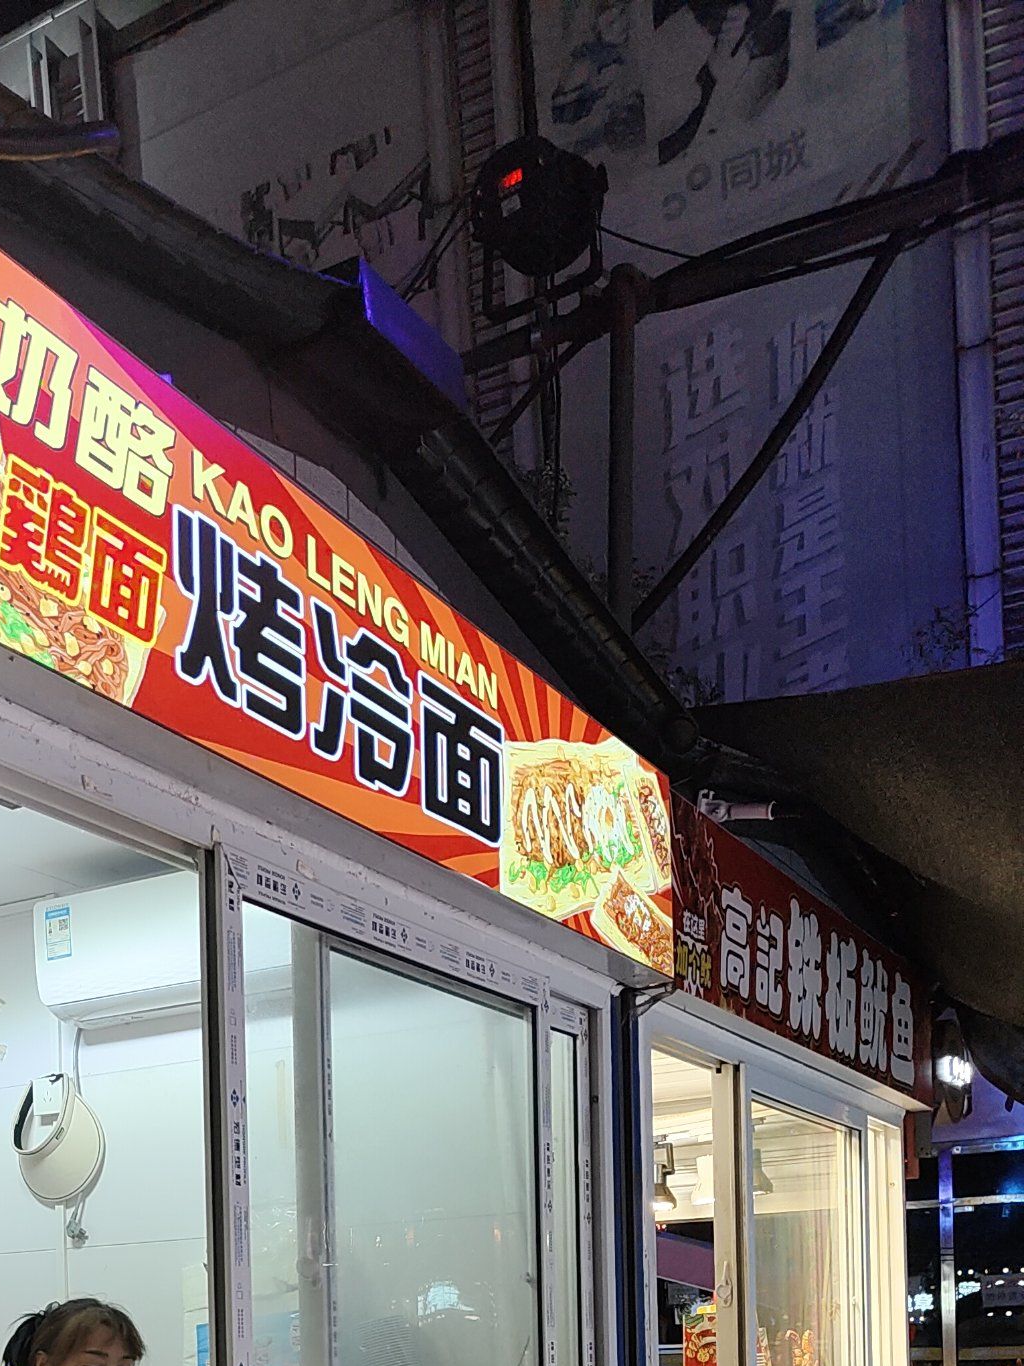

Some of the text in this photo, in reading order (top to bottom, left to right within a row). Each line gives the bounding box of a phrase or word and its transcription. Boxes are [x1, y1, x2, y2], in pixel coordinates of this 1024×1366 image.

[172, 502, 506, 848] 烤冷面
[193, 449, 499, 710] KAO LENG MIAN
